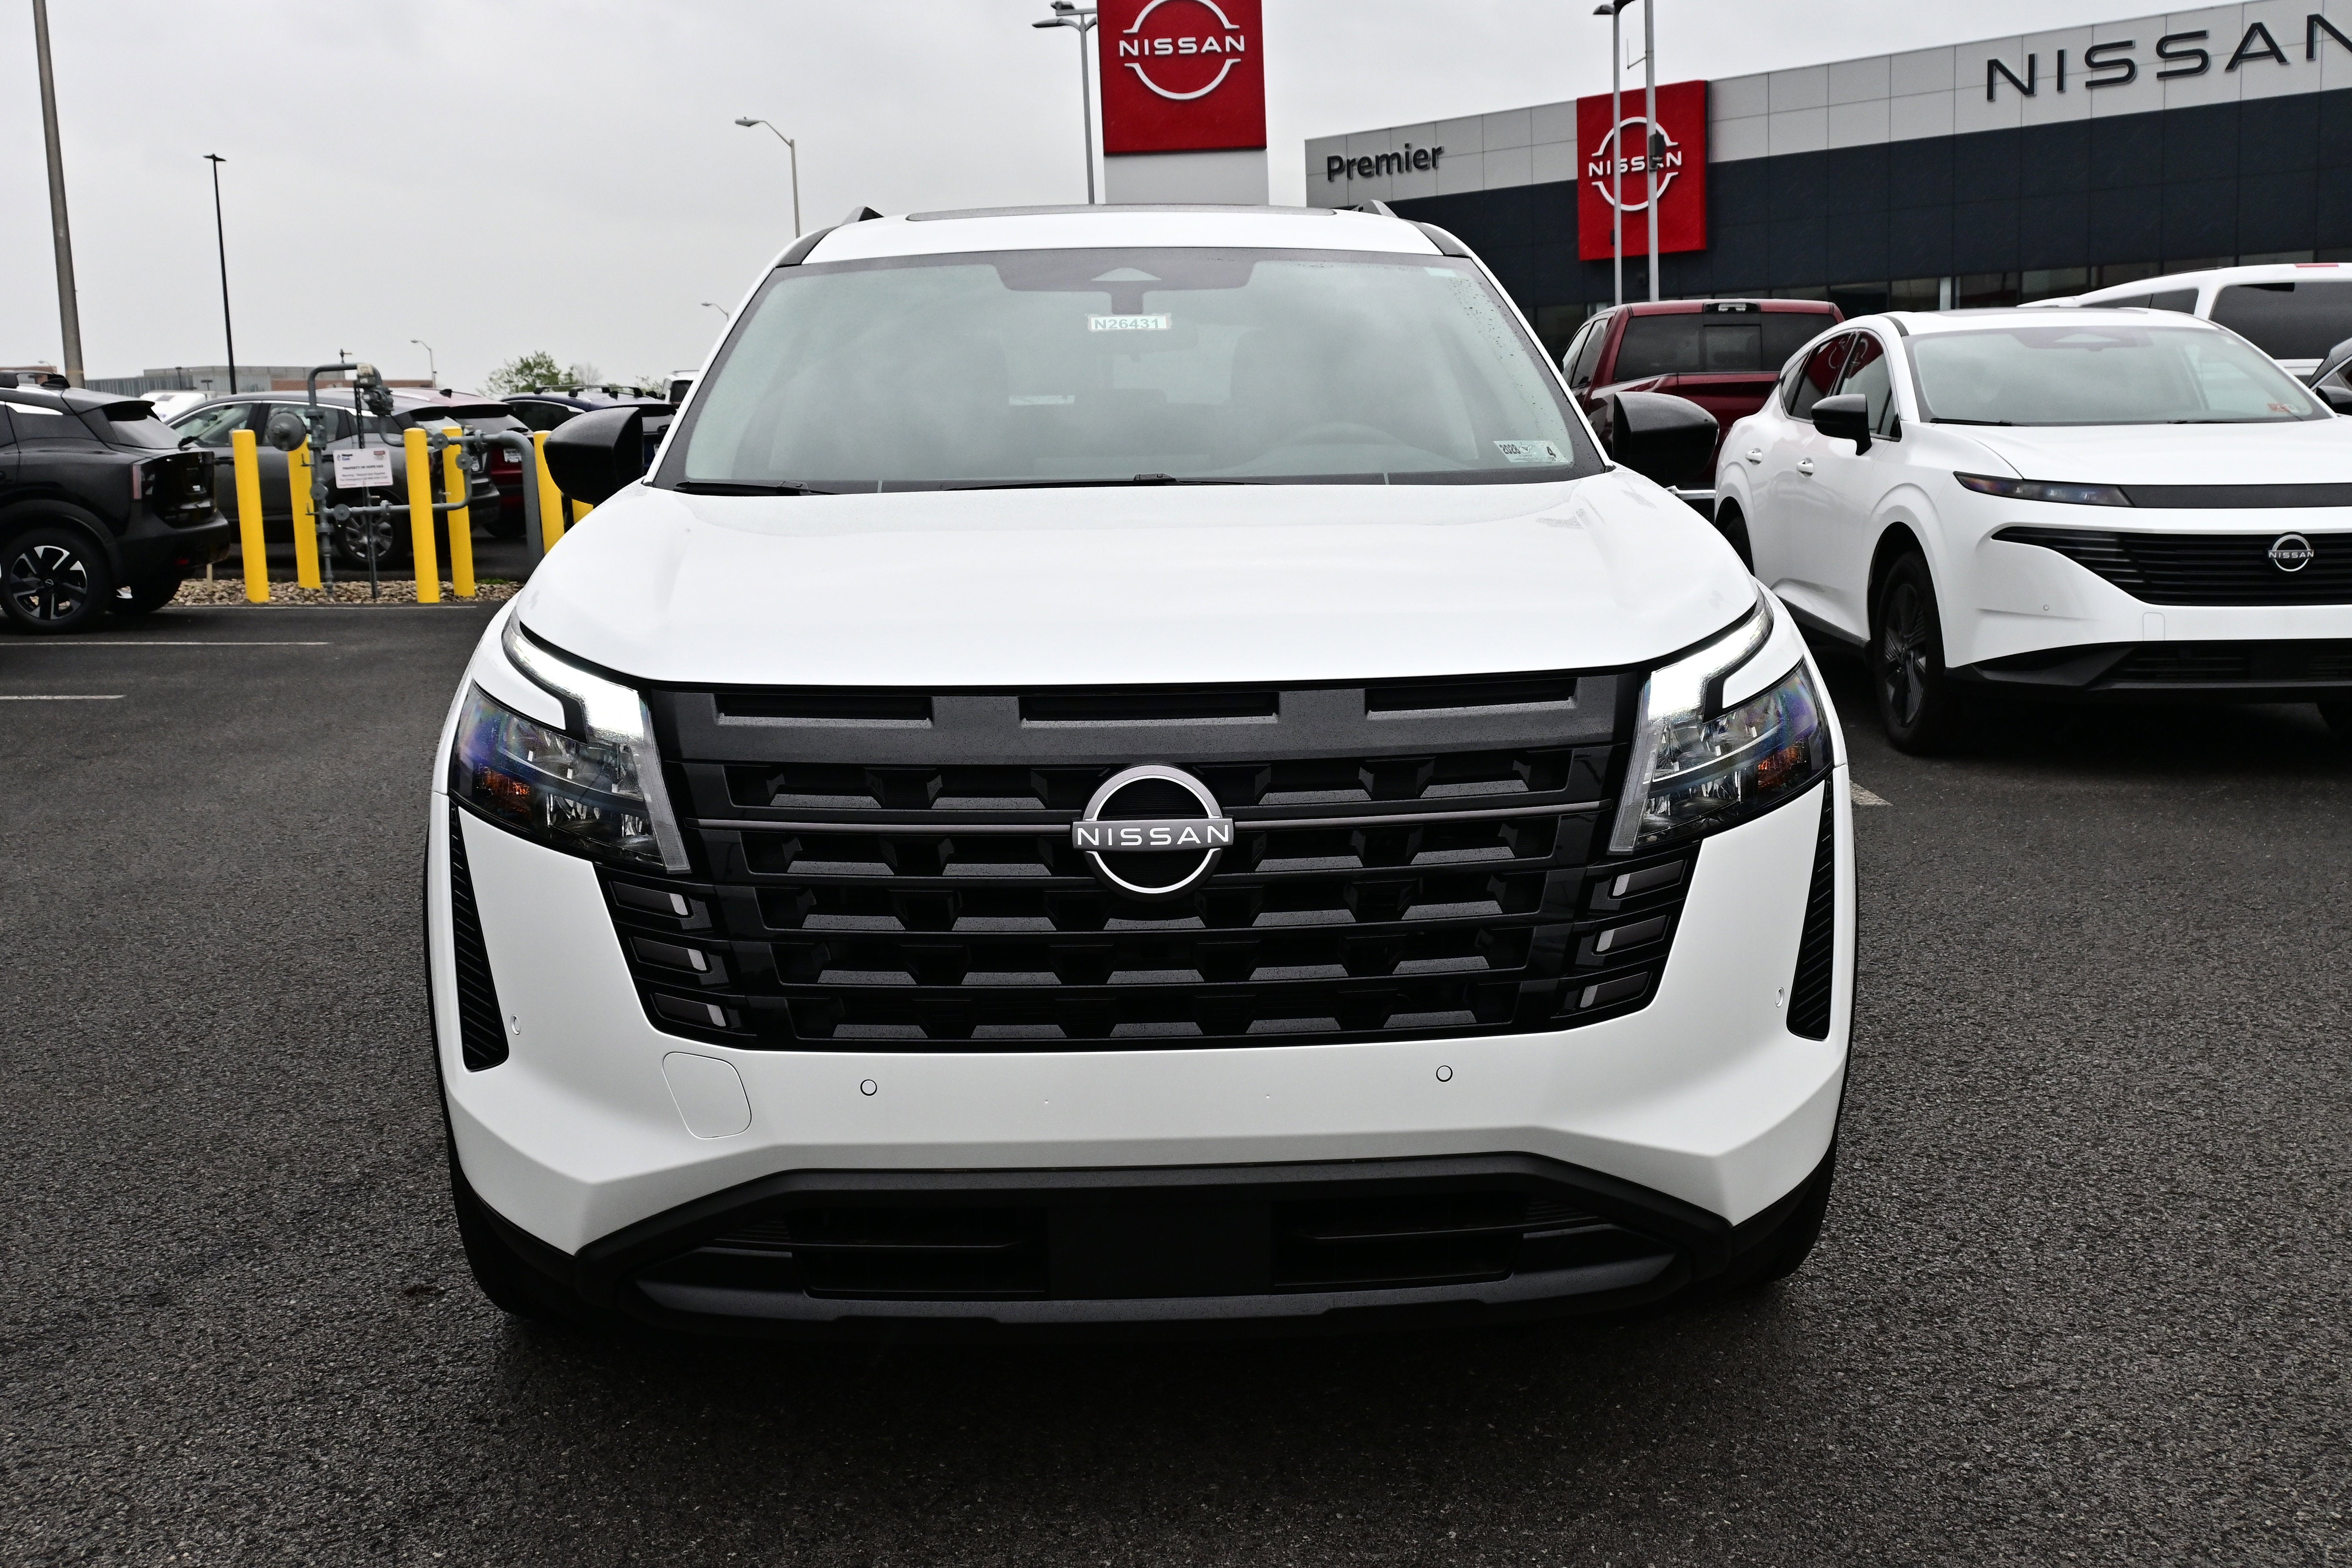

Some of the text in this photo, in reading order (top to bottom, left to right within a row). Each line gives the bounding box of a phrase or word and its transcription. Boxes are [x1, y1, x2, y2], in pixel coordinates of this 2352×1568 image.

[1119, 35, 1245, 57] NISSAN
[1327, 143, 1444, 182] Premier
[1589, 151, 1682, 177] NISSN
[1094, 318, 1158, 329] N26431
[1499, 444, 1557, 458] 2028 4
[1077, 825, 1229, 846] NISSAN
